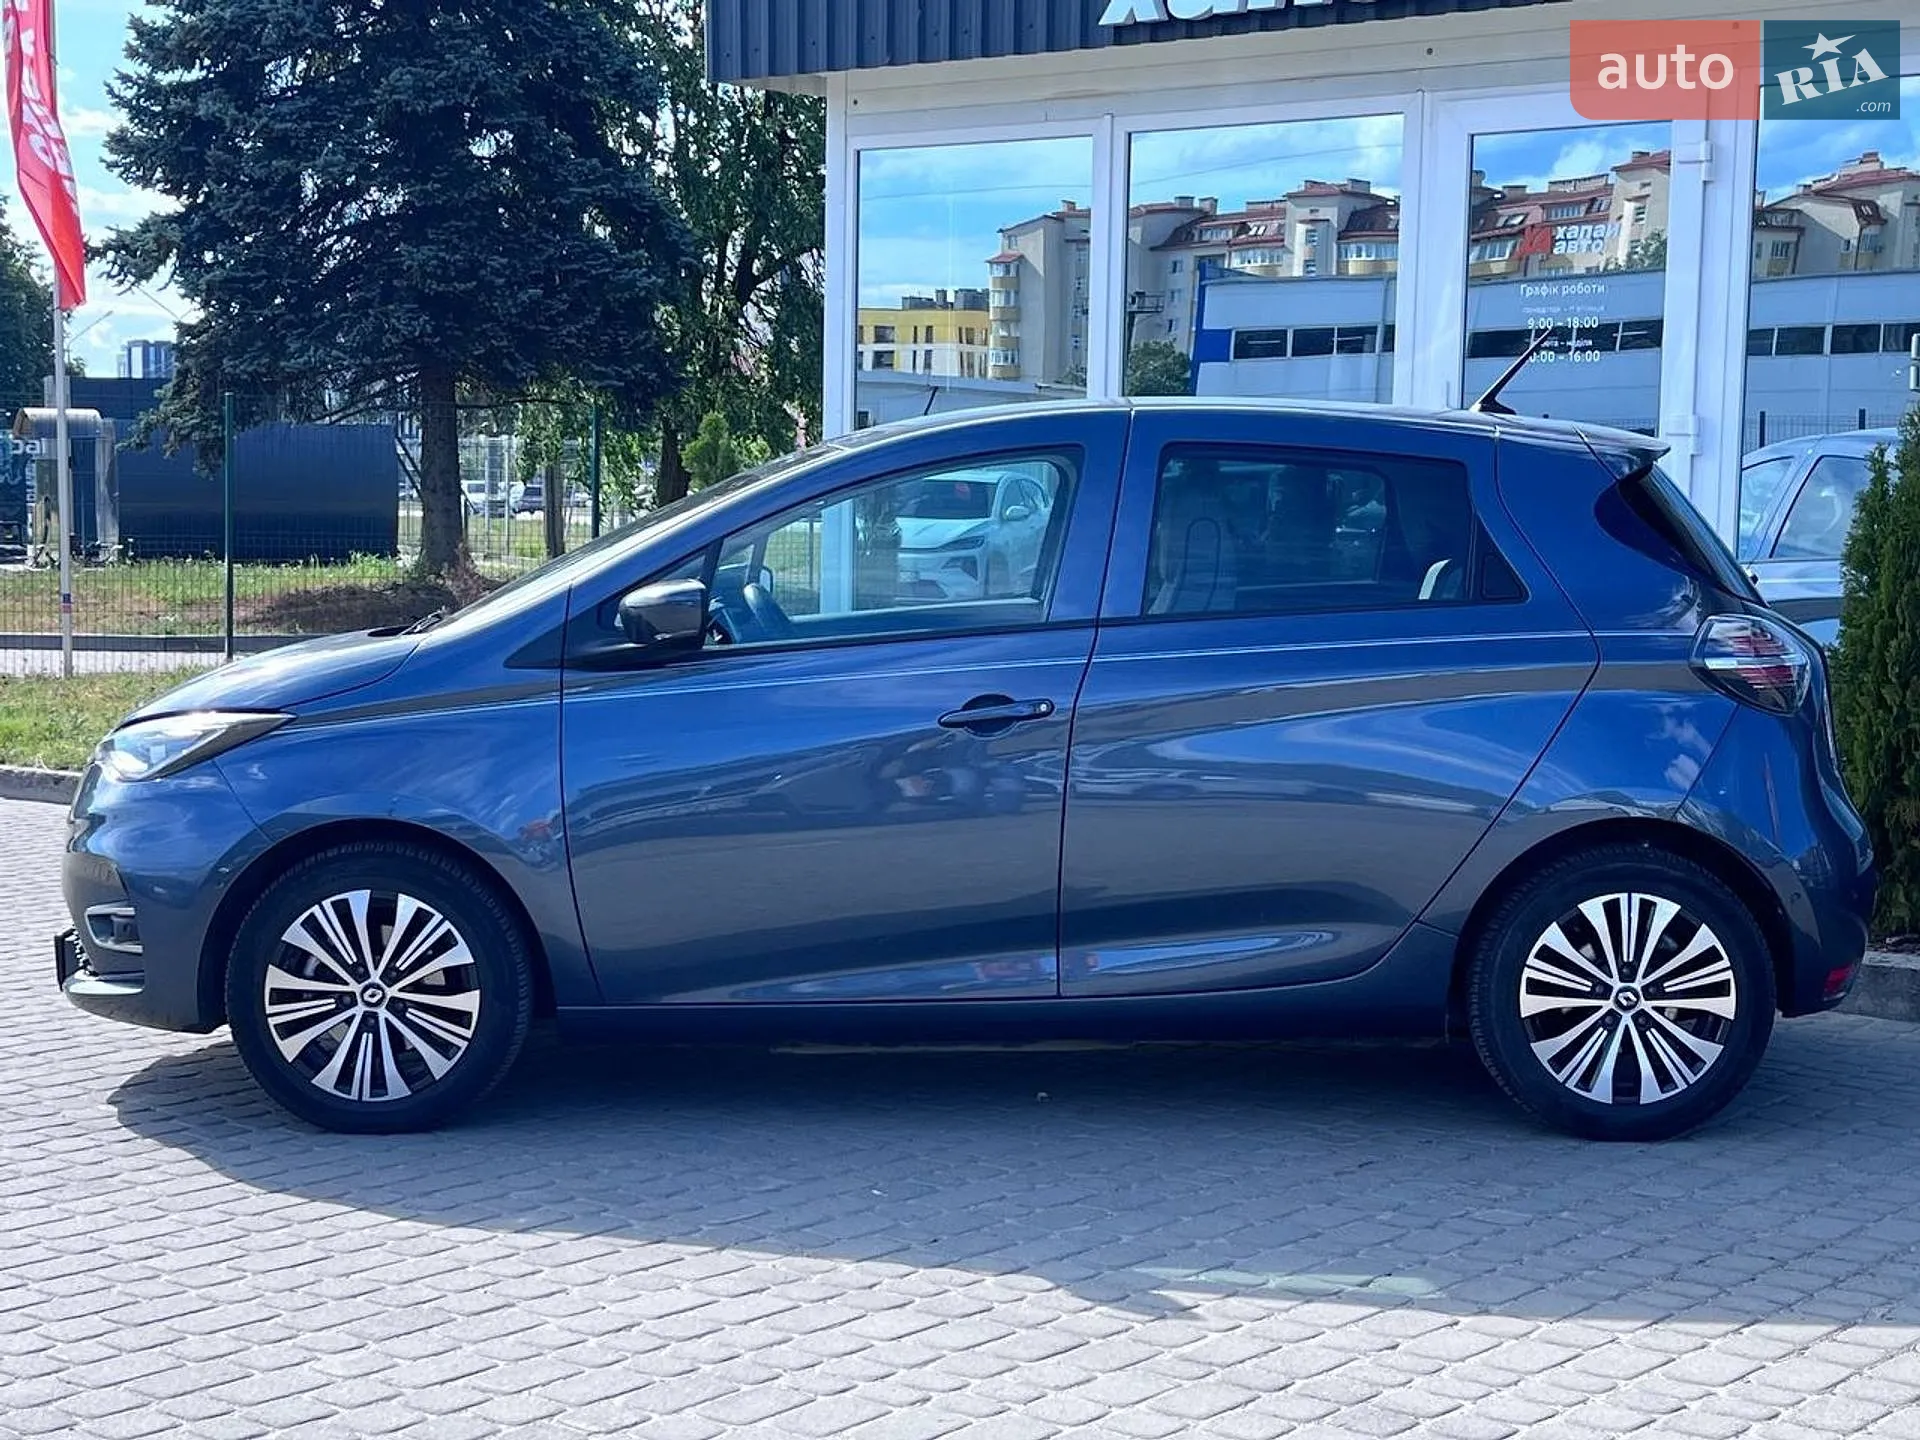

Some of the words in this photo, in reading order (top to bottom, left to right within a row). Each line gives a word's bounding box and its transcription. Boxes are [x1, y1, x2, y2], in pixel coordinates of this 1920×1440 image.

[1561, 281, 1605, 297] роботи
[1567, 315, 1599, 329] 18:00
[1568, 349, 1601, 363] 16:00
